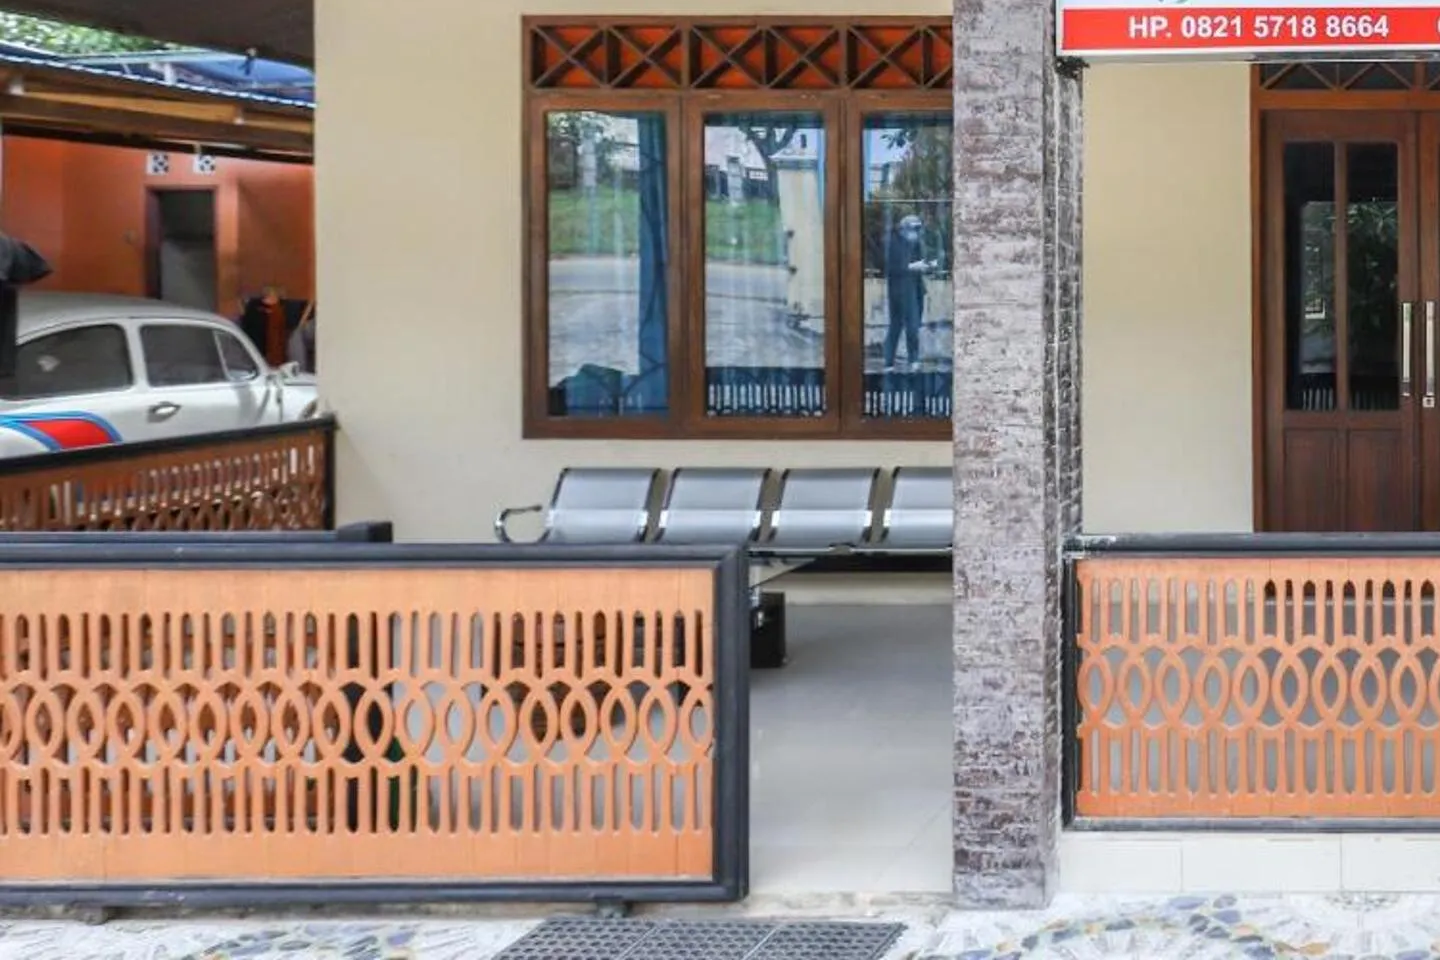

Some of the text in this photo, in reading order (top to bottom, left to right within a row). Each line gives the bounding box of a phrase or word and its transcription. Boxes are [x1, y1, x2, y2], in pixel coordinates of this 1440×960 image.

[1128, 15, 1389, 38] HP. 0821 5718 8664
